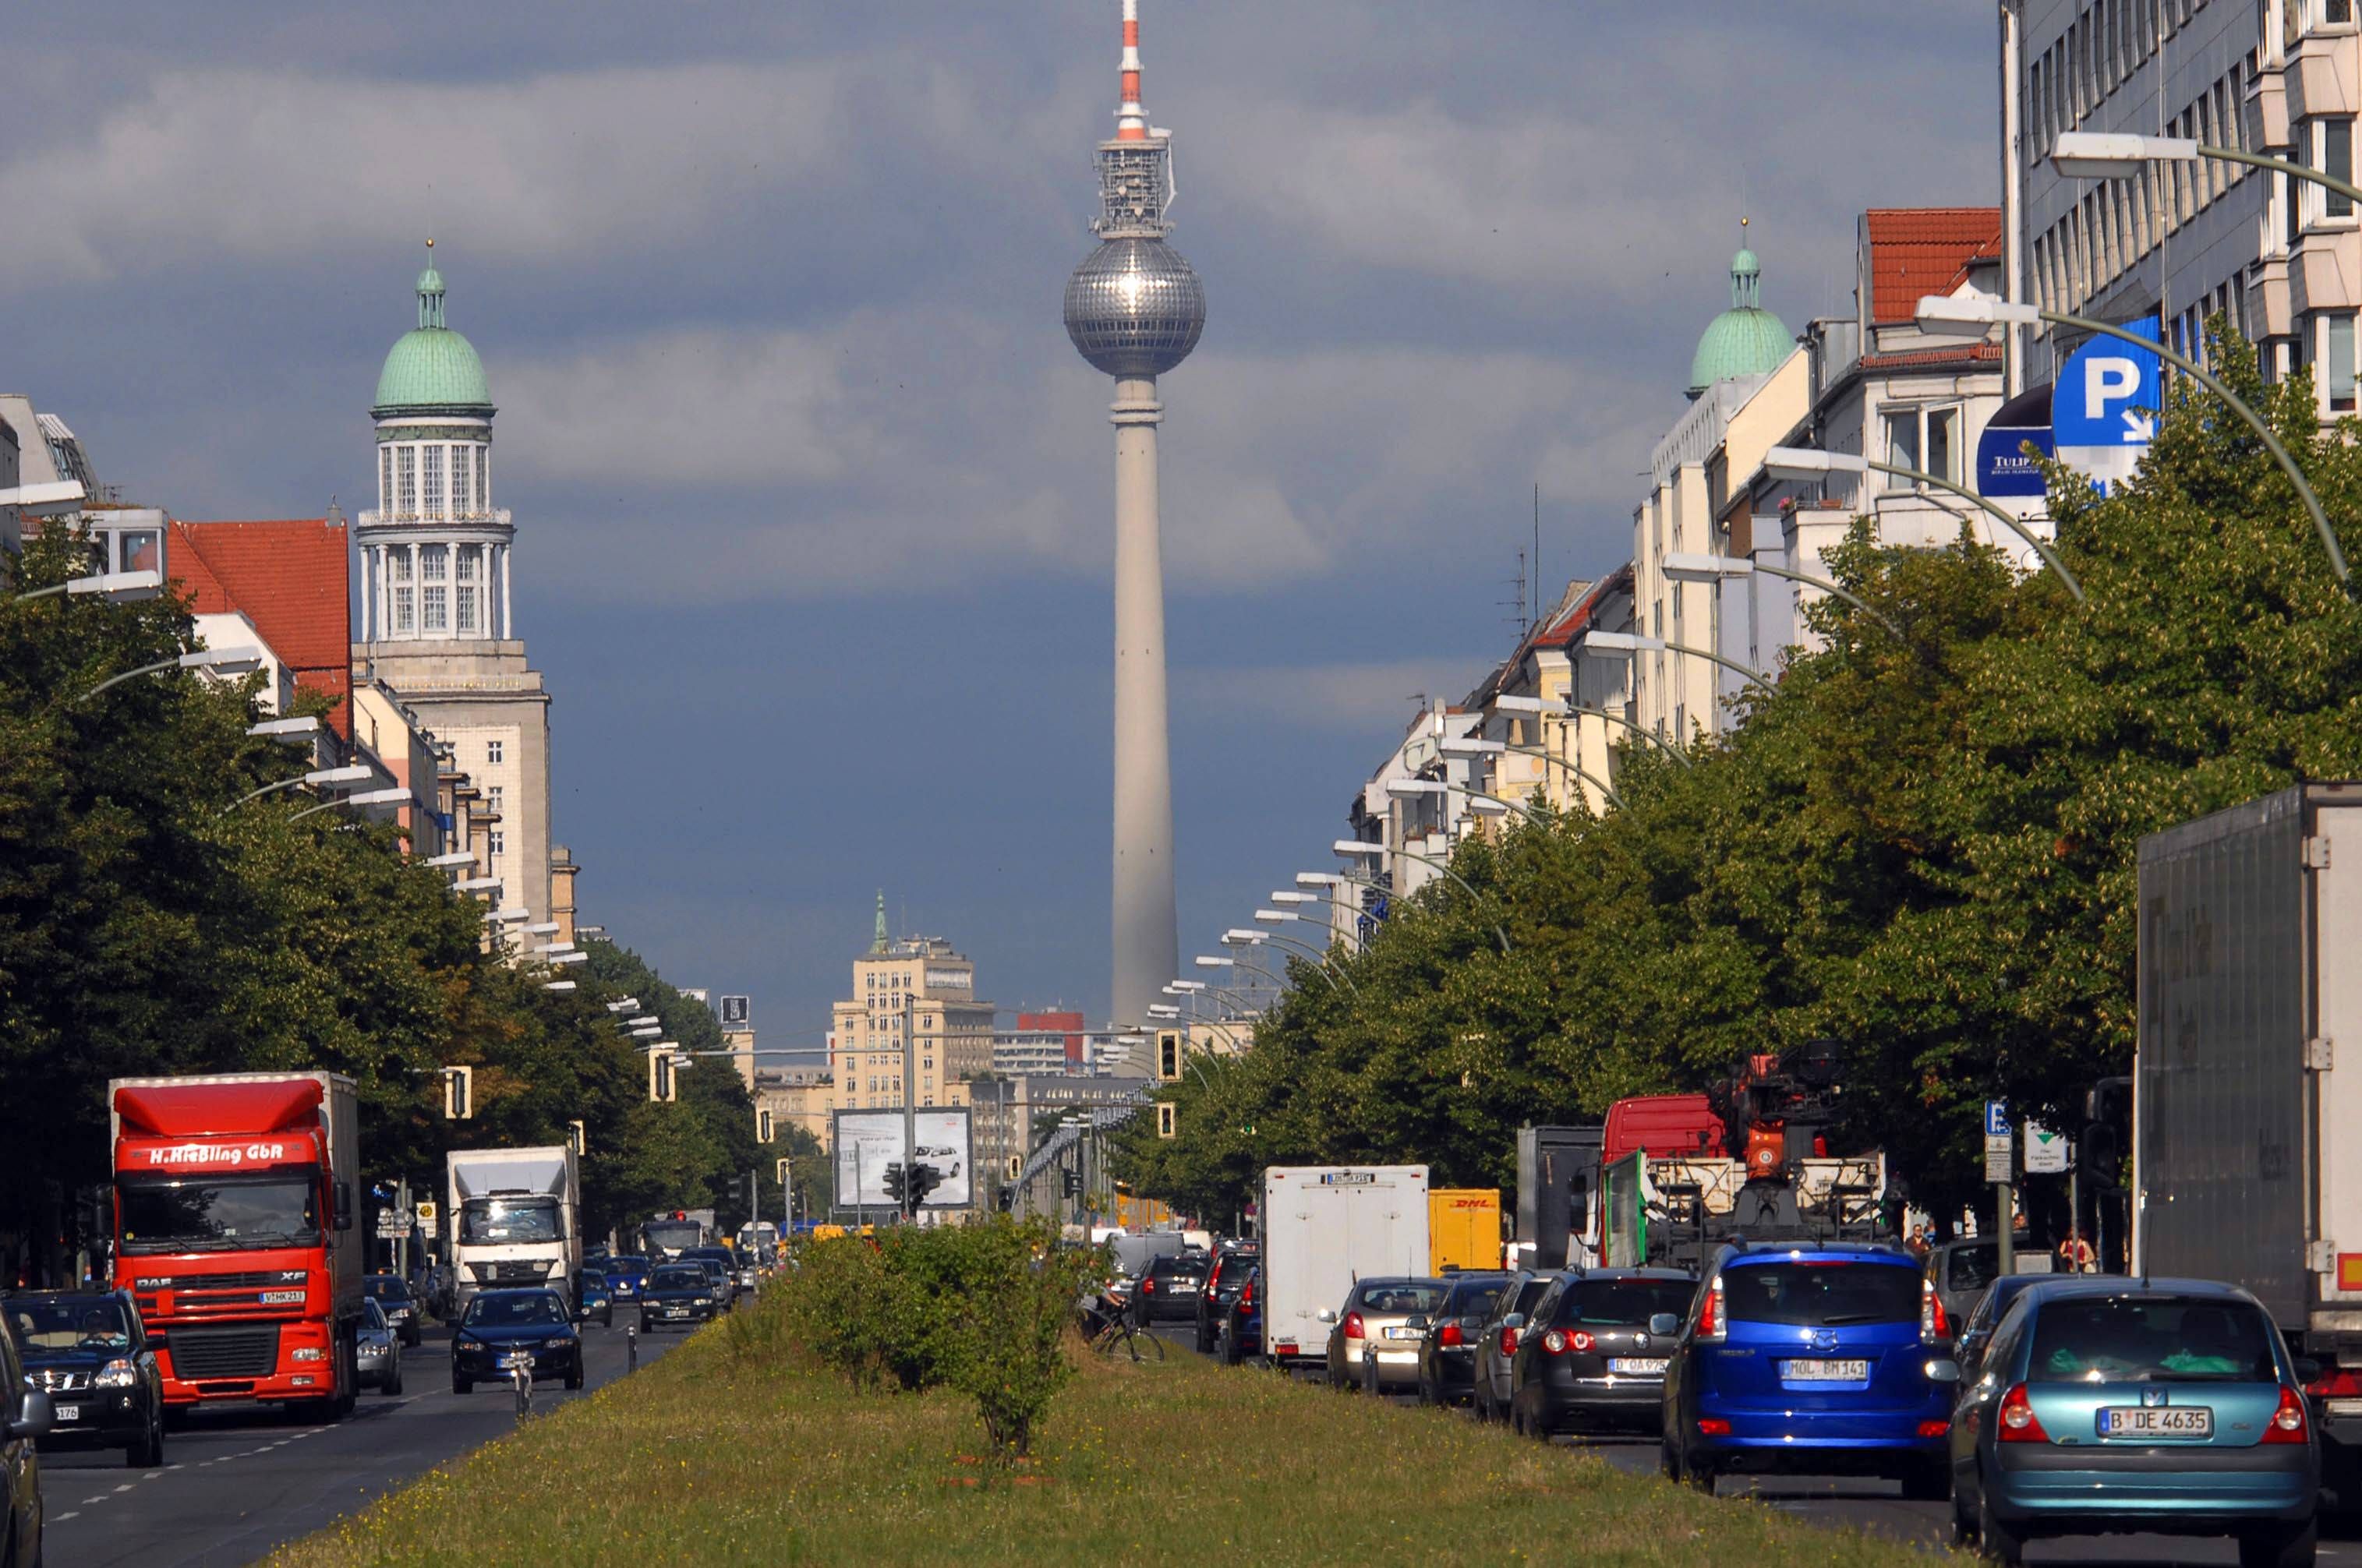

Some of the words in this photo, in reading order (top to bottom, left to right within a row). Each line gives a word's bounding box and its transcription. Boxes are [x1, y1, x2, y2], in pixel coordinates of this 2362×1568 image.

[2085, 357, 2141, 419] P
[1994, 456, 2029, 467] TULIP
[246, 1144, 283, 1160] GbR
[136, 1277, 171, 1287] DAF
[281, 1272, 306, 1280] XF
[1790, 1361, 1814, 1375] MOL
[1842, 1360, 1865, 1375] 141
[2111, 1412, 2122, 1429] B
[2135, 1412, 2158, 1429] DE
[2162, 1412, 2205, 1429] 4635
